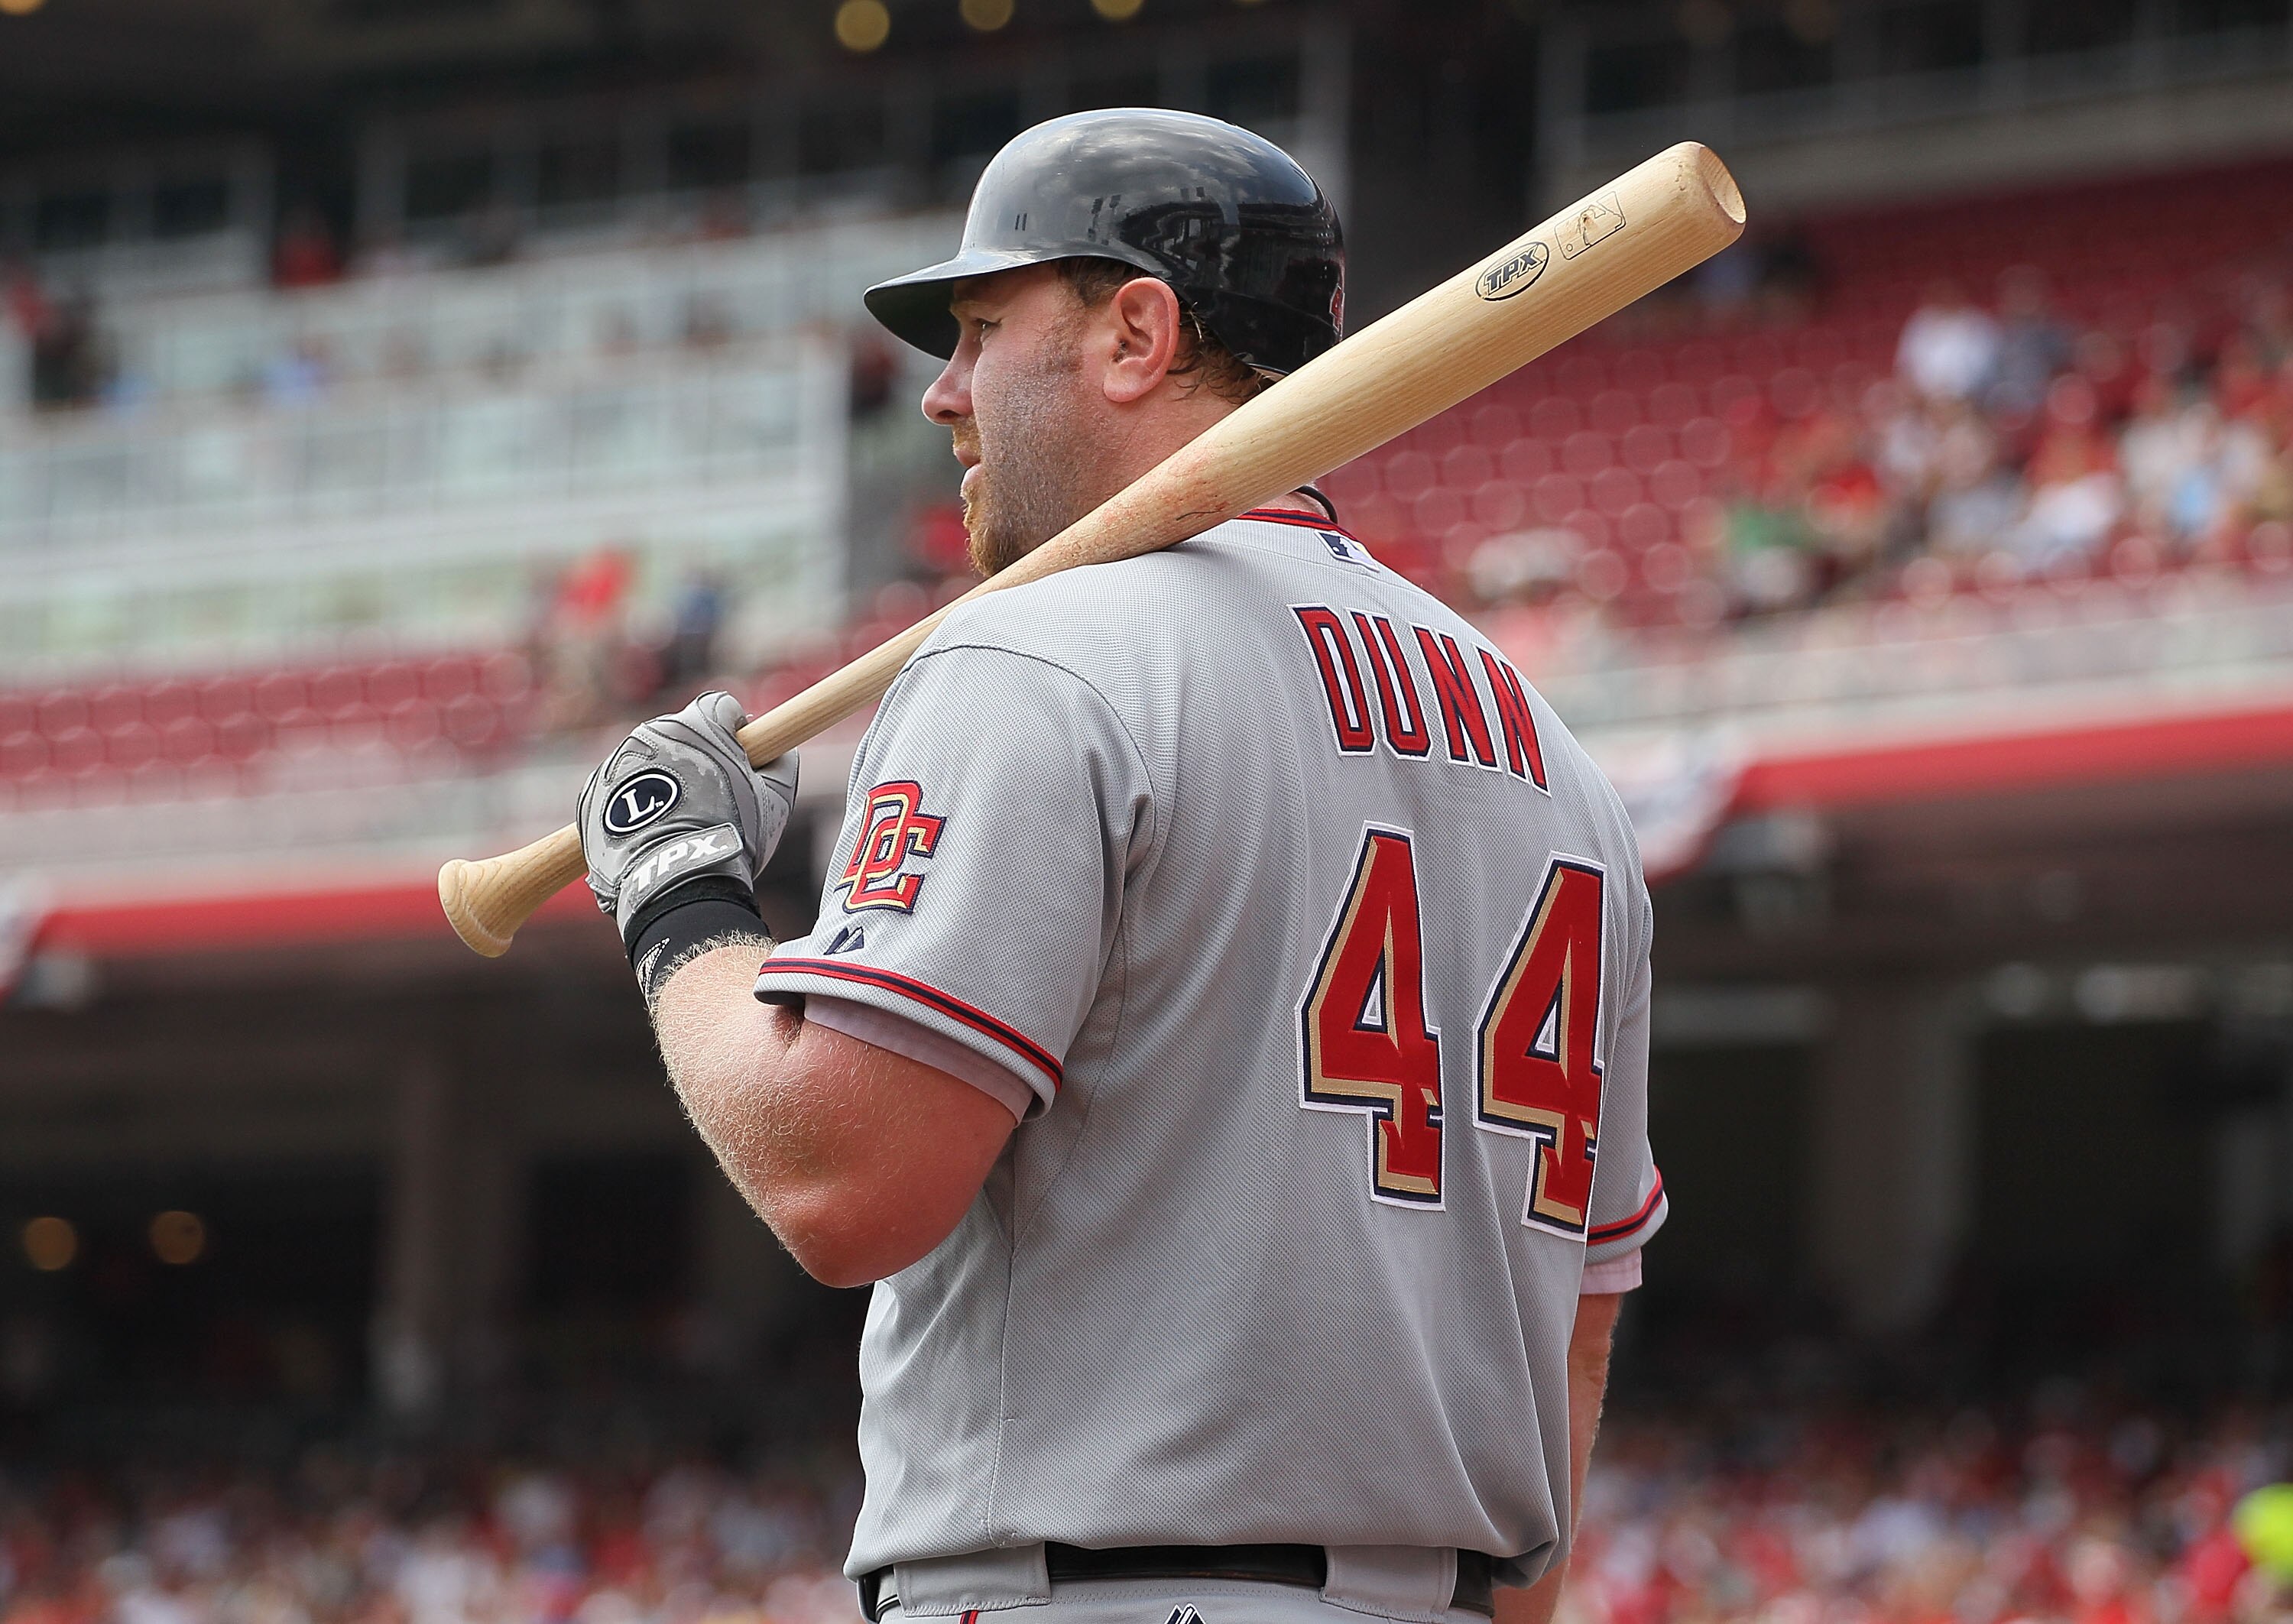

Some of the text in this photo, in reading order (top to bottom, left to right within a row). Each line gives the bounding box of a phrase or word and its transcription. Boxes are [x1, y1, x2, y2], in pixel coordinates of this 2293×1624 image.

[1484, 245, 1542, 296] TPX
[1287, 603, 1551, 797] DUNN
[1295, 820, 1607, 1242] 44
